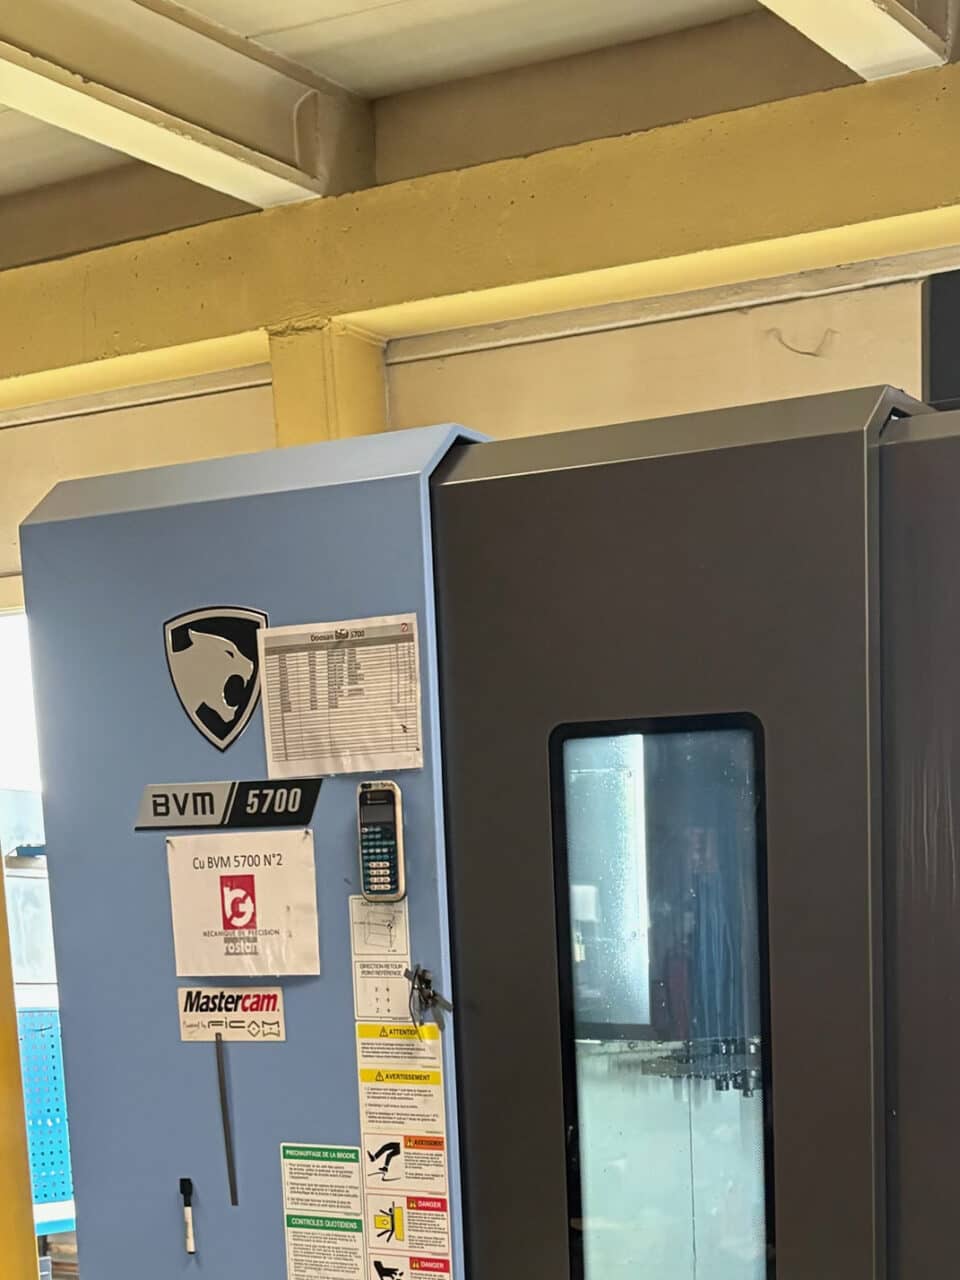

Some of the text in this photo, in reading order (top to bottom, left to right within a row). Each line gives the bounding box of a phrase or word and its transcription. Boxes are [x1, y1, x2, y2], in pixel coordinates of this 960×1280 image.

[152, 788, 302, 817] BVM 5700
[193, 853, 283, 869] Cu BVM 5700 N°2
[184, 990, 278, 1012] Mastercam
[389, 1028, 418, 1036] ATTENTIO
[418, 1200, 442, 1208] DANGER
[420, 1260, 445, 1268] DANGER
